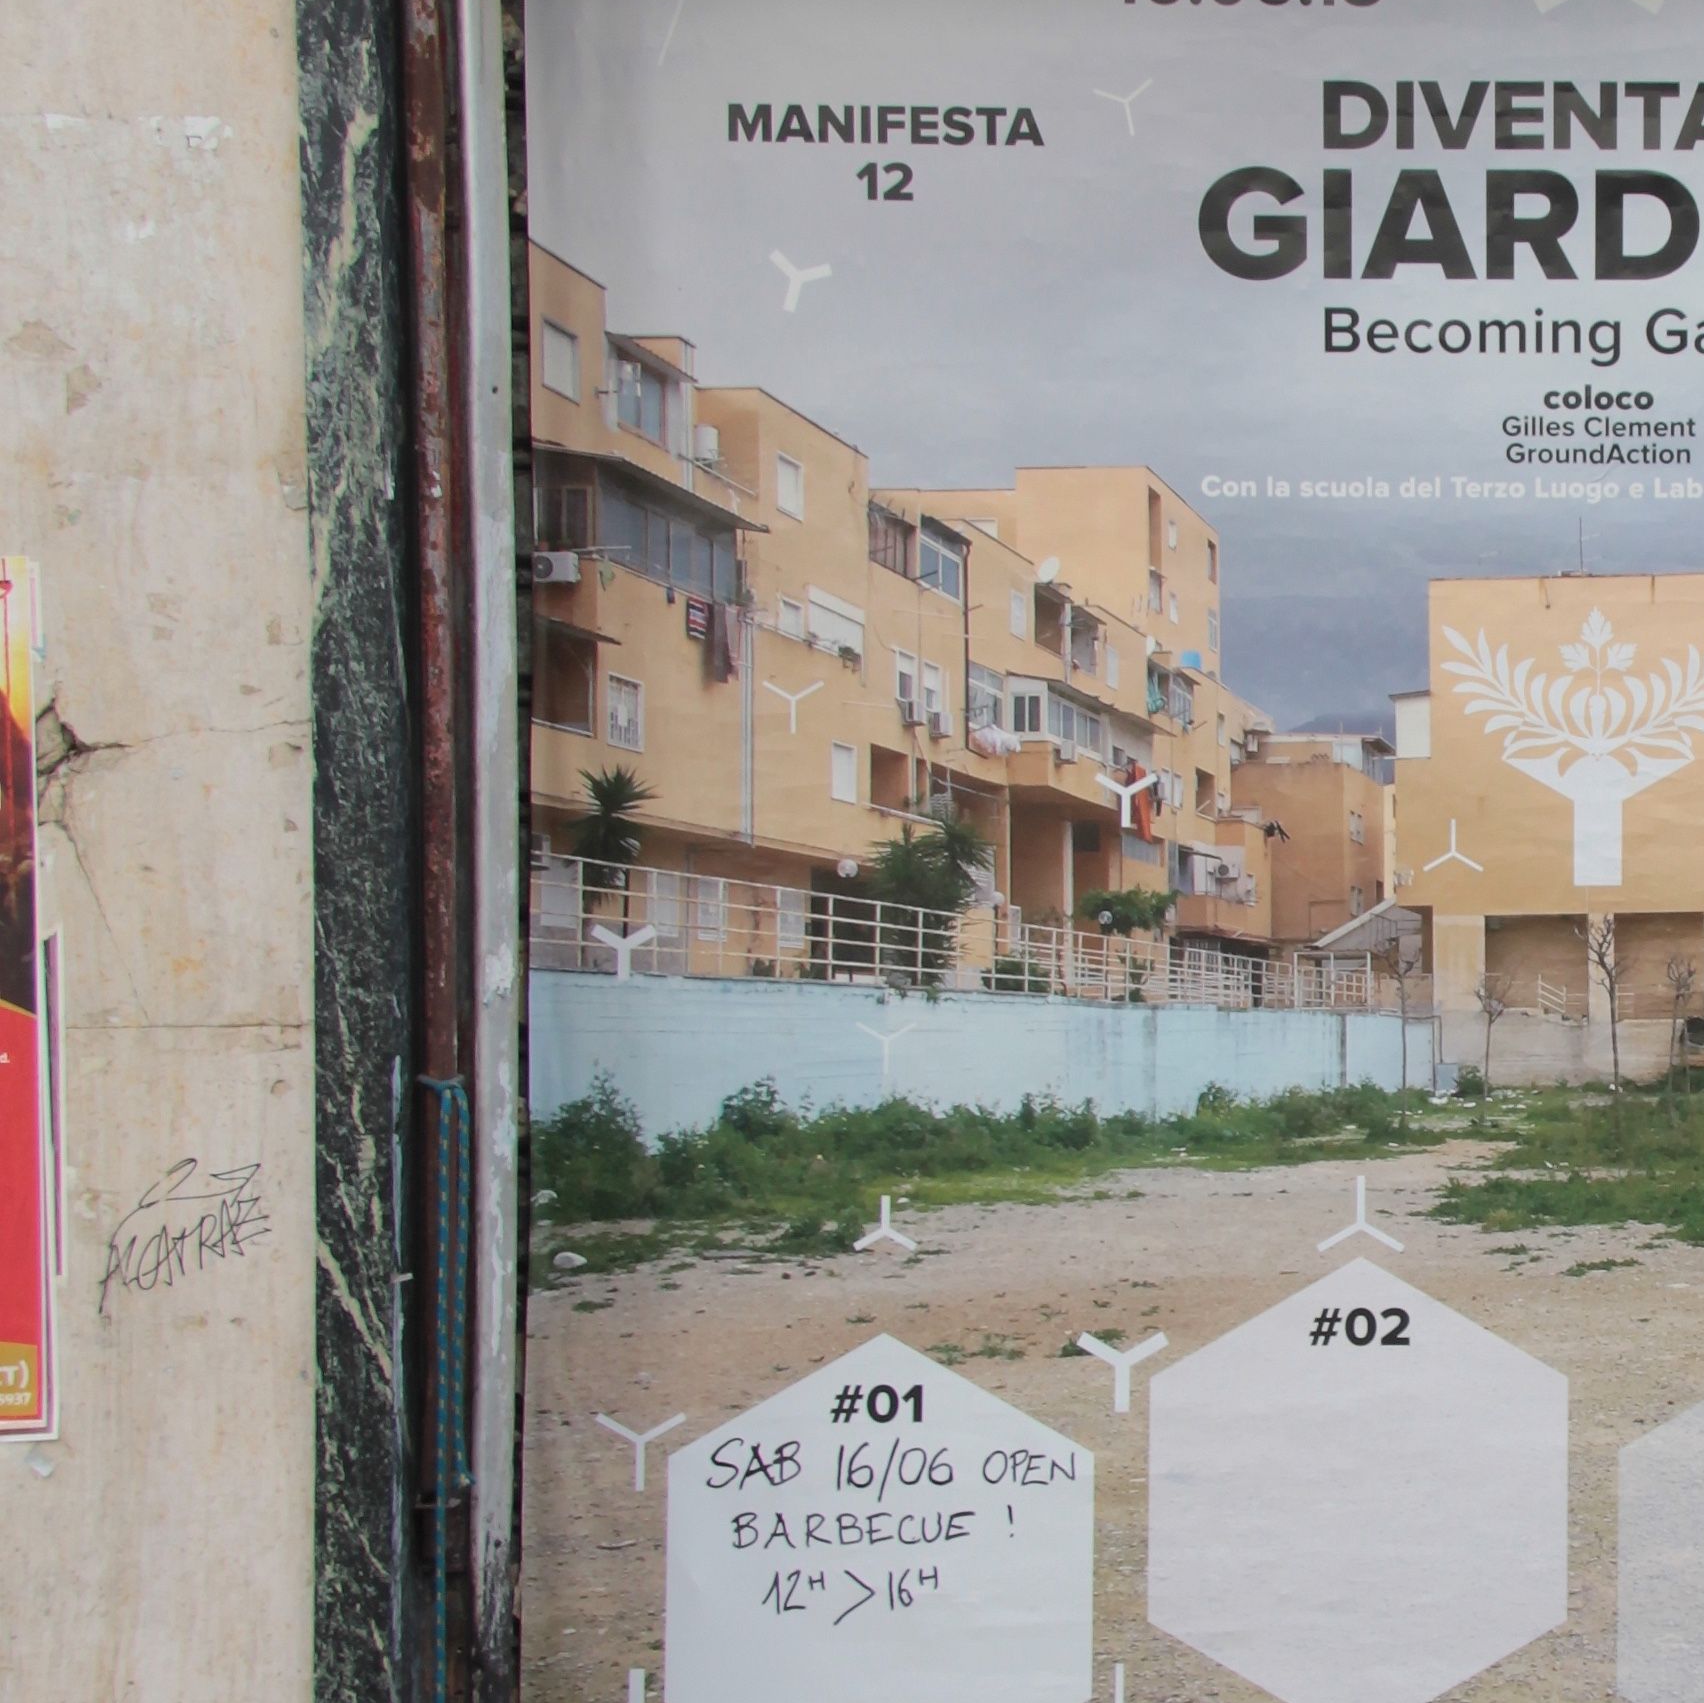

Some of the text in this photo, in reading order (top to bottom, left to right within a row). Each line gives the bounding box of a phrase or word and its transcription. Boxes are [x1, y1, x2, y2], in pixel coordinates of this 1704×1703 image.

[729, 104, 1044, 146] MANIFESTA
[857, 163, 913, 200] 12
[1325, 308, 1620, 366] Becoming
[1544, 385, 1653, 410] coloco
[1503, 416, 1695, 437] Gilles Clement
[1507, 443, 1690, 464] GroundAction
[1202, 476, 1257, 497] Con
[1267, 476, 1289, 497] la
[1301, 476, 1389, 498] scuola
[1400, 476, 1440, 497] del
[1452, 476, 1525, 498] Terzo
[1535, 477, 1619, 504] Luogo
[1629, 483, 1644, 498] e
[1310, 1308, 1409, 1346] #02
[831, 1385, 922, 1423] #01
[707, 1438, 1075, 1502] SAB 16/06 OPEN
[732, 1511, 974, 1549] BARBECUE
